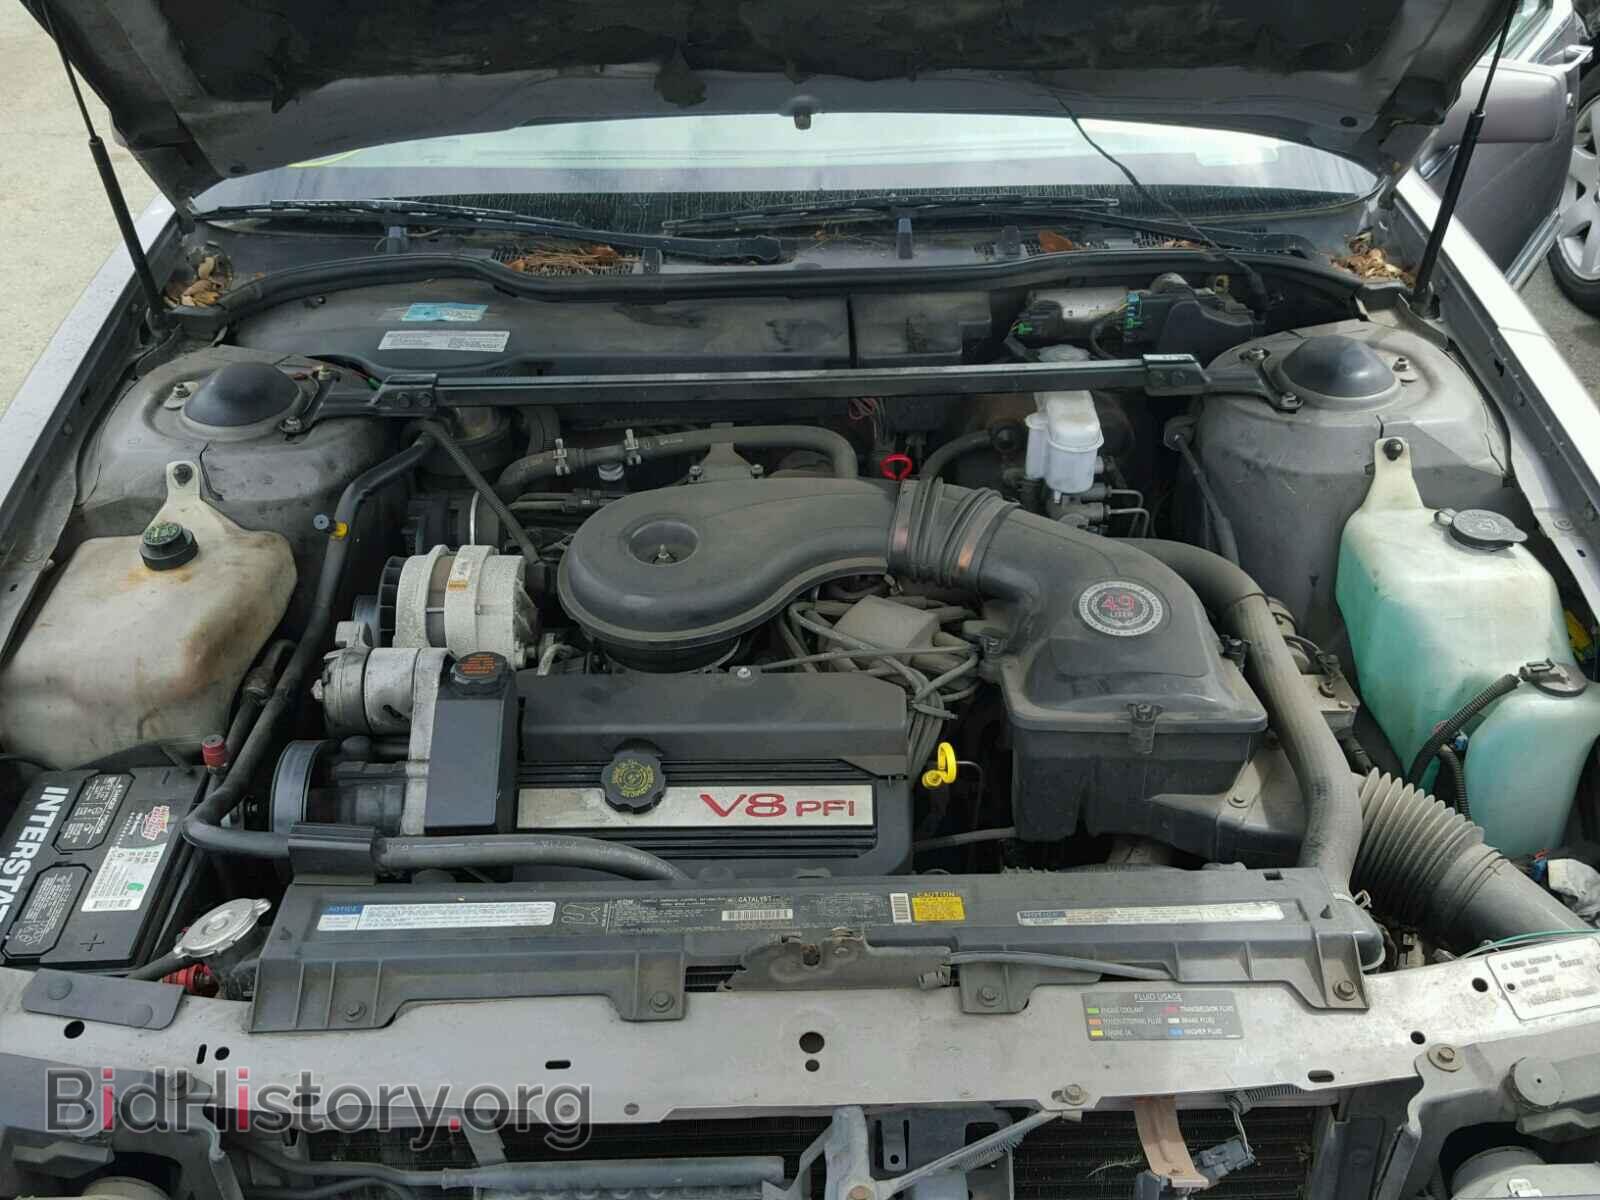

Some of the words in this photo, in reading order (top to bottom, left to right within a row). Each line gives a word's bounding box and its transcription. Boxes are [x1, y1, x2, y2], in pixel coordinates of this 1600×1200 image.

[700, 793, 787, 817] V8
[795, 800, 855, 817] PFI
[1134, 992, 1156, 1001] FLUID
[1157, 992, 1183, 1001] USAGE
